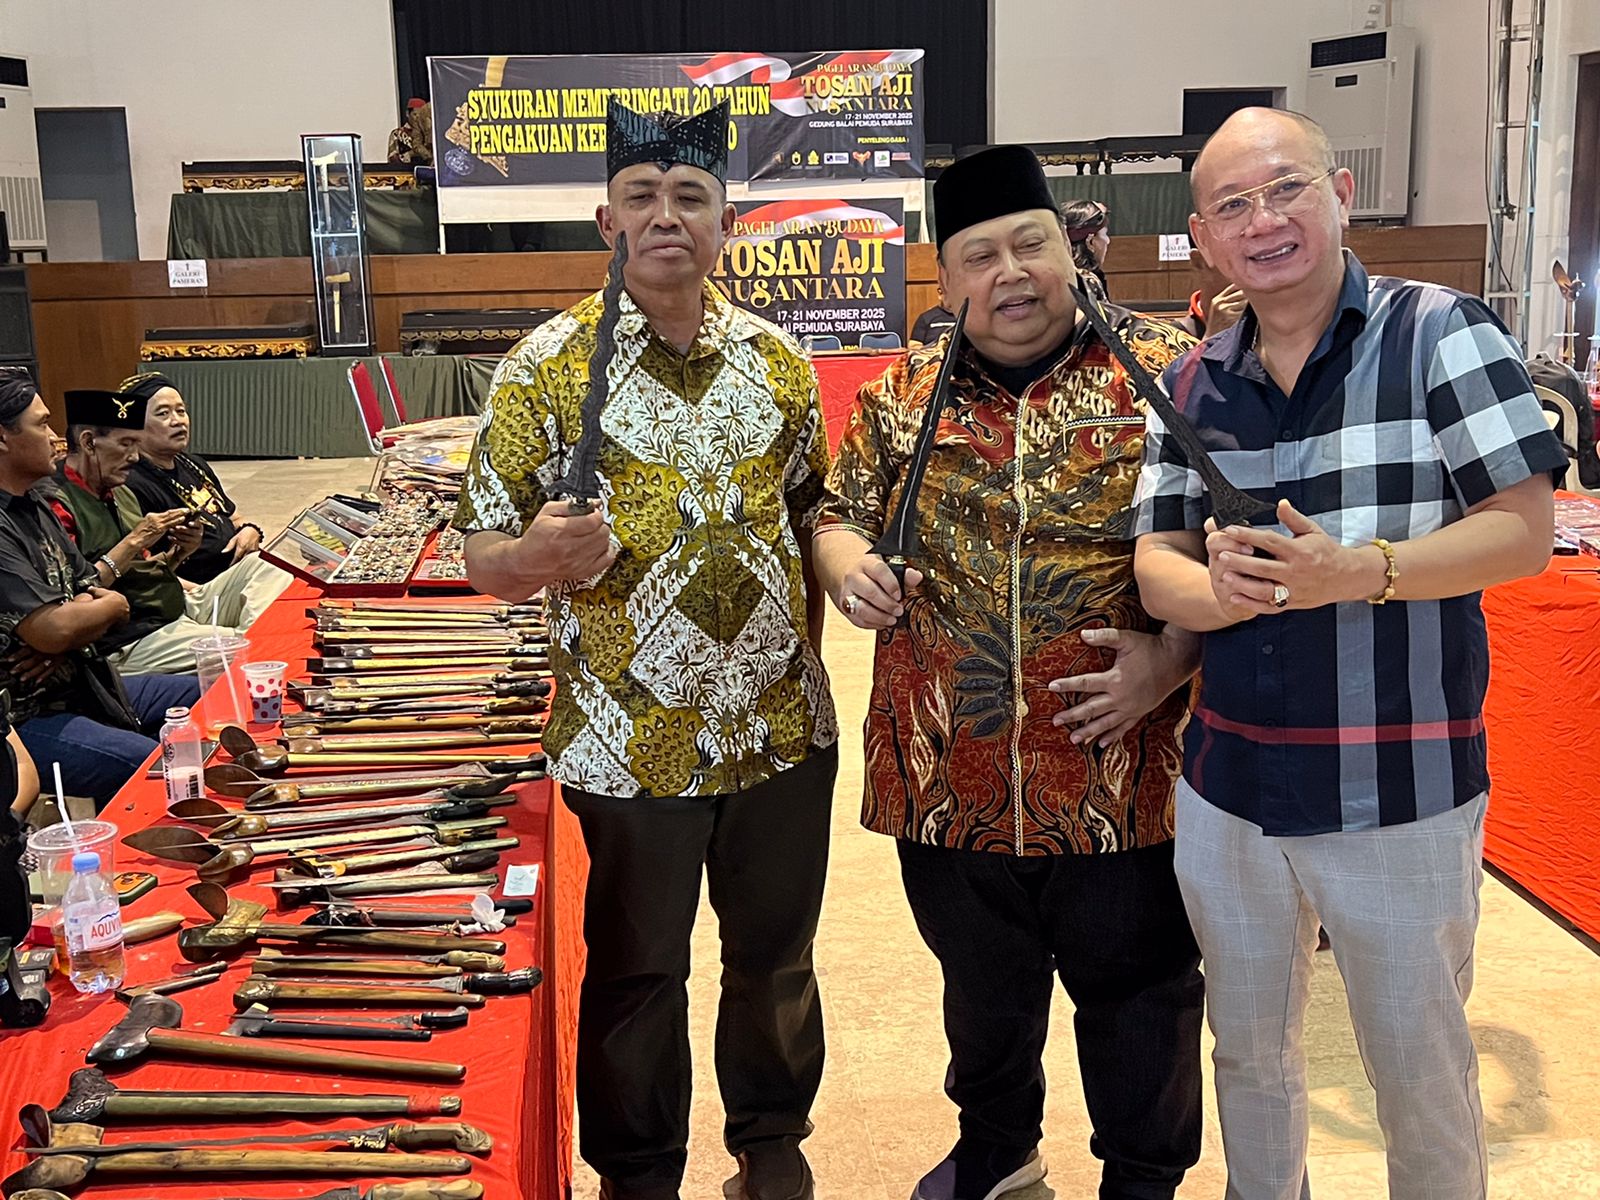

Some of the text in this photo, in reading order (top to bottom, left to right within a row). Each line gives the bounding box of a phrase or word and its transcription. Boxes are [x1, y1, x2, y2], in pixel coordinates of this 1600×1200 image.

[801, 73, 913, 97] TOSAN AJI
[467, 89, 558, 119] SYUKURAN
[692, 86, 711, 116] 20
[713, 85, 770, 115] TAHUN
[808, 120, 835, 128] GEDUNG
[881, 119, 913, 127] SURABAYA
[862, 112, 897, 120] NOVEMBER
[469, 123, 573, 154] PENGAKUAN
[733, 217, 885, 239] PAGELARAN BUDAYA
[712, 238, 886, 278] TOSAN AJI
[715, 276, 885, 309] NUSANTARA
[805, 308, 860, 320] NOVEMBER
[860, 308, 886, 319] 2025
[792, 321, 833, 333] PEMUDA
[834, 320, 886, 332] SURABAYA
